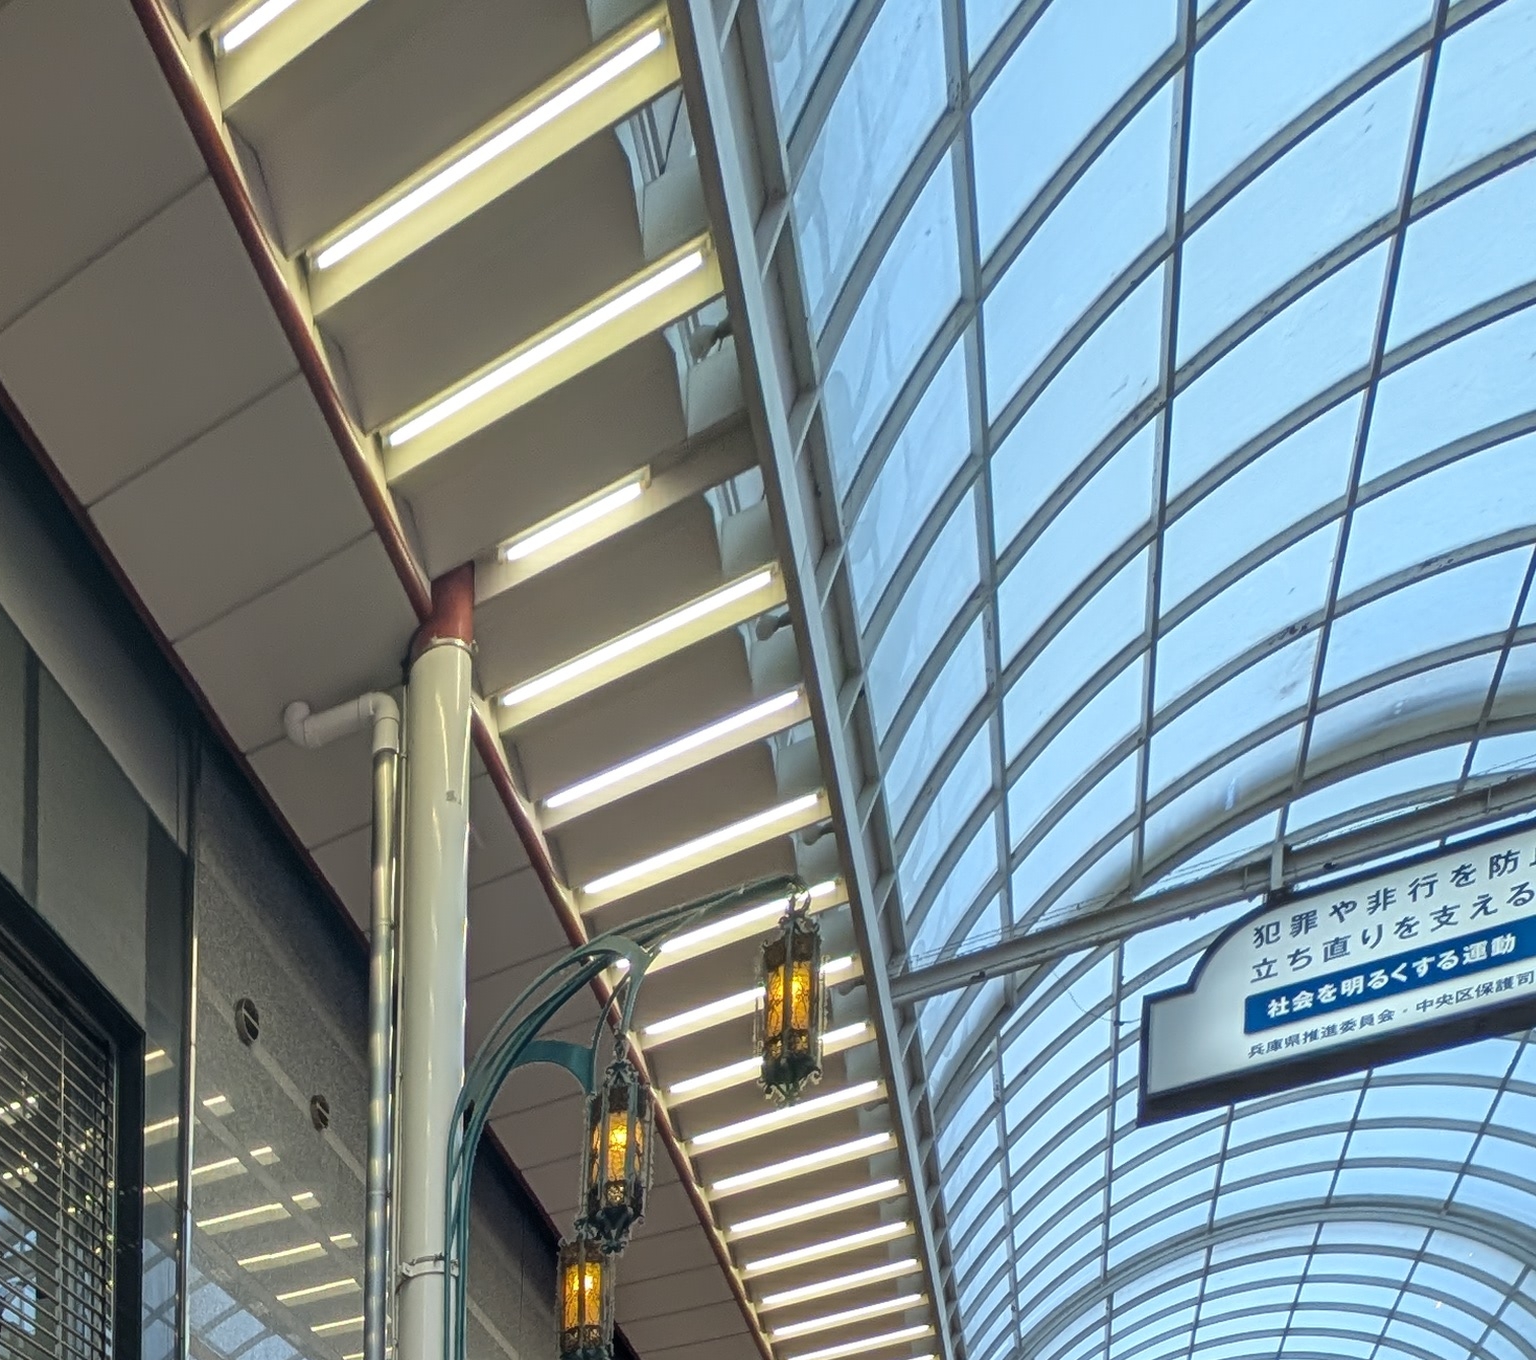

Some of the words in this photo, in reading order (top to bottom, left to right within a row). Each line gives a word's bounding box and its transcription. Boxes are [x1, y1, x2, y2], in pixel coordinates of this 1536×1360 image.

[1250, 881, 1536, 984] 立ち直りを支える
[1266, 932, 1517, 1019] 社会を明るくする運動
